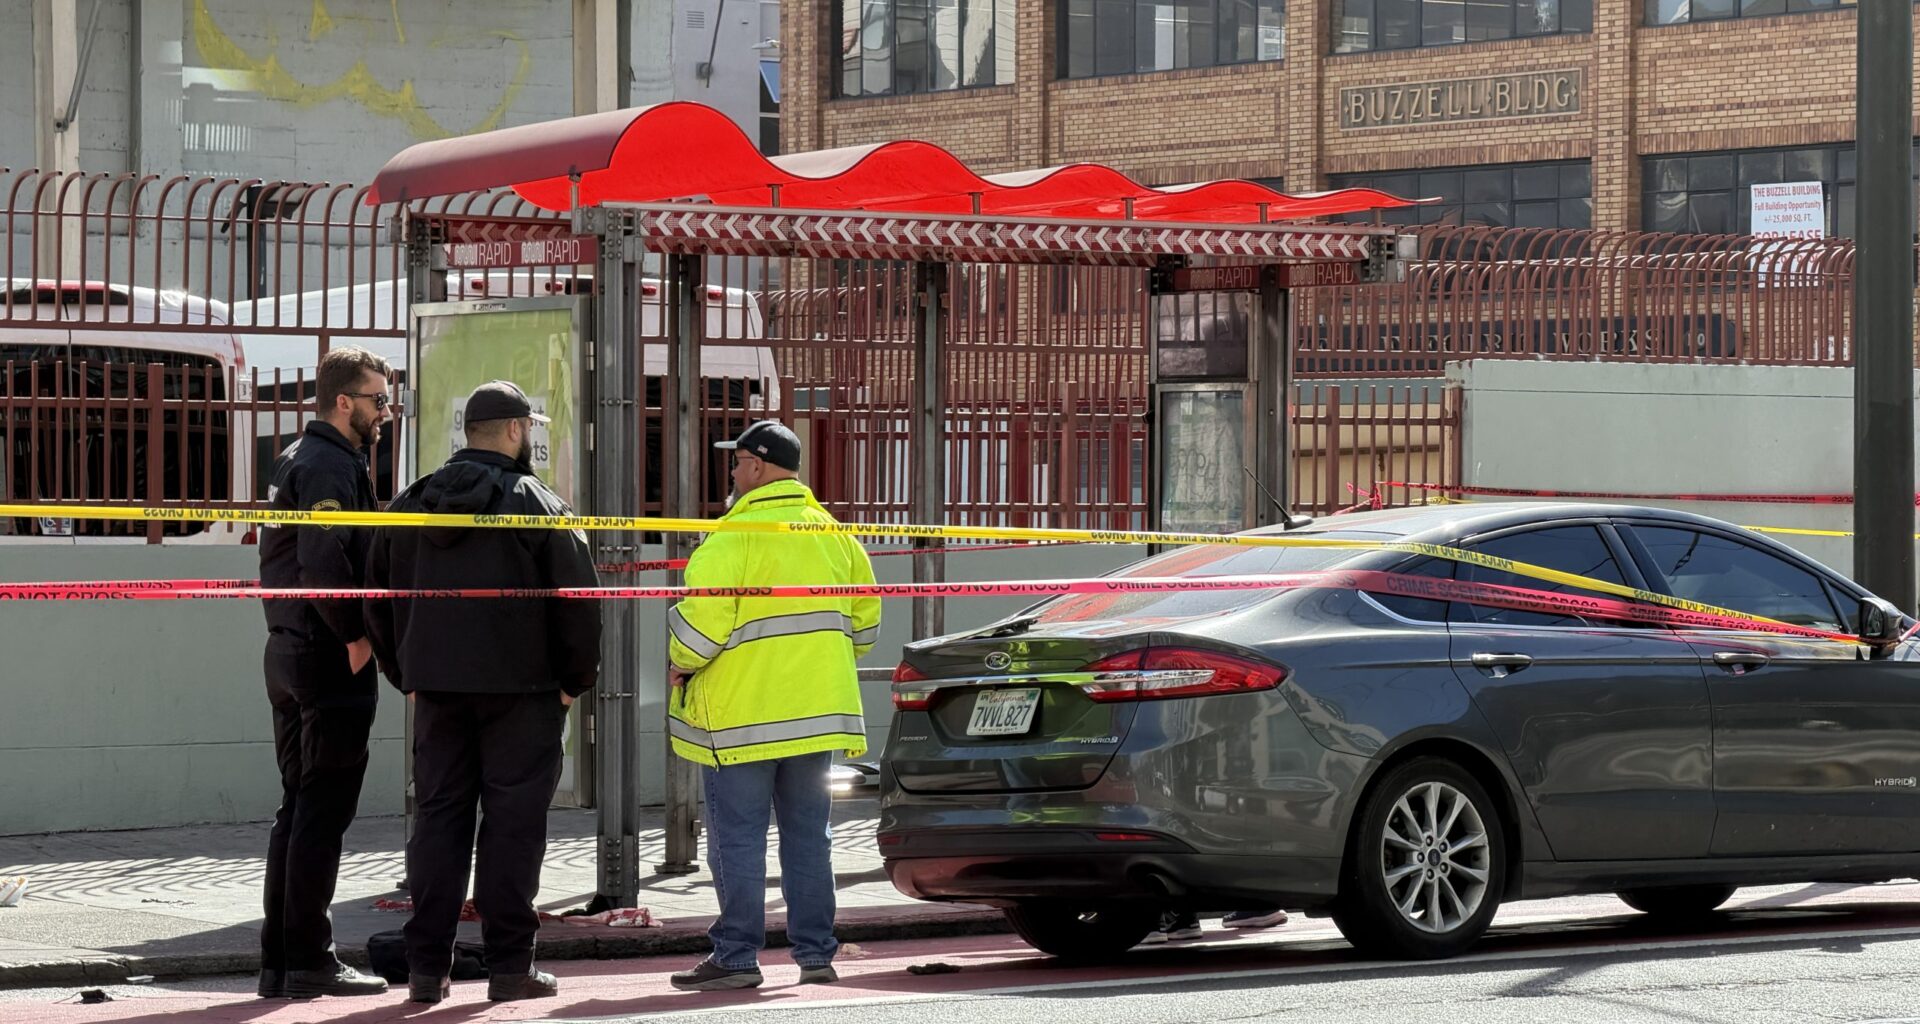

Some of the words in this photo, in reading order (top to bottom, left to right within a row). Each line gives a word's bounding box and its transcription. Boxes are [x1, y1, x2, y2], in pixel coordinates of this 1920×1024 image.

[1351, 84, 1483, 123] BUZZELL
[1496, 76, 1571, 112] BLDG
[1754, 188, 1765, 198] THE
[1766, 186, 1792, 197] BUZZELL
[1792, 185, 1821, 196] BUILDING
[1754, 202, 1765, 211] Full
[1765, 201, 1788, 212] Building
[1788, 200, 1821, 212] Opportunity
[478, 242, 512, 266] RAPID
[546, 239, 580, 263] RAPID
[1216, 267, 1253, 288] RAPID
[1316, 262, 1354, 284] RAPID
[1386, 575, 1438, 596] CRIME
[1439, 580, 1491, 601] SCENE
[1516, 592, 1547, 610] NOT
[1550, 596, 1603, 615] CROSS
[974, 704, 1032, 728] 7VVL827
[1874, 778, 1910, 786] HYBRID
